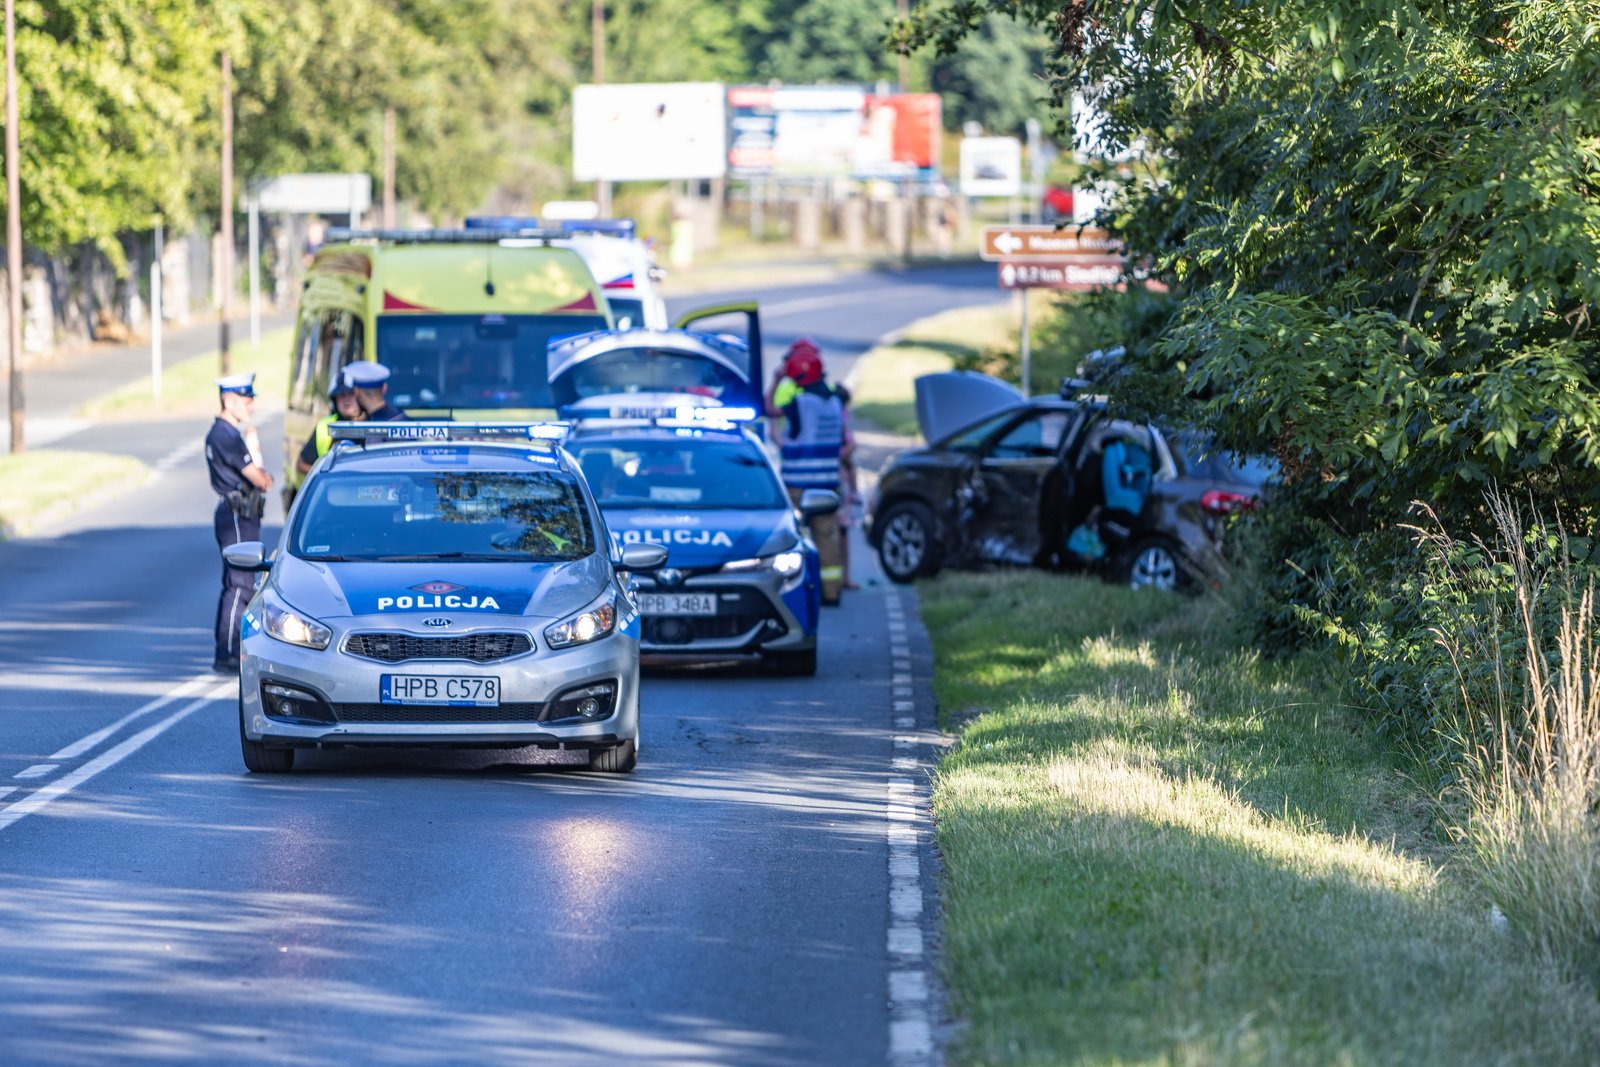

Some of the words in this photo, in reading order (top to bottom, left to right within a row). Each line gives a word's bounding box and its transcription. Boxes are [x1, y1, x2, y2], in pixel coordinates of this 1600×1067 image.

[389, 428, 446, 438] POLICJA
[378, 595, 500, 610] POLICJA
[394, 678, 438, 698] HPB
[446, 679, 495, 699] C578
